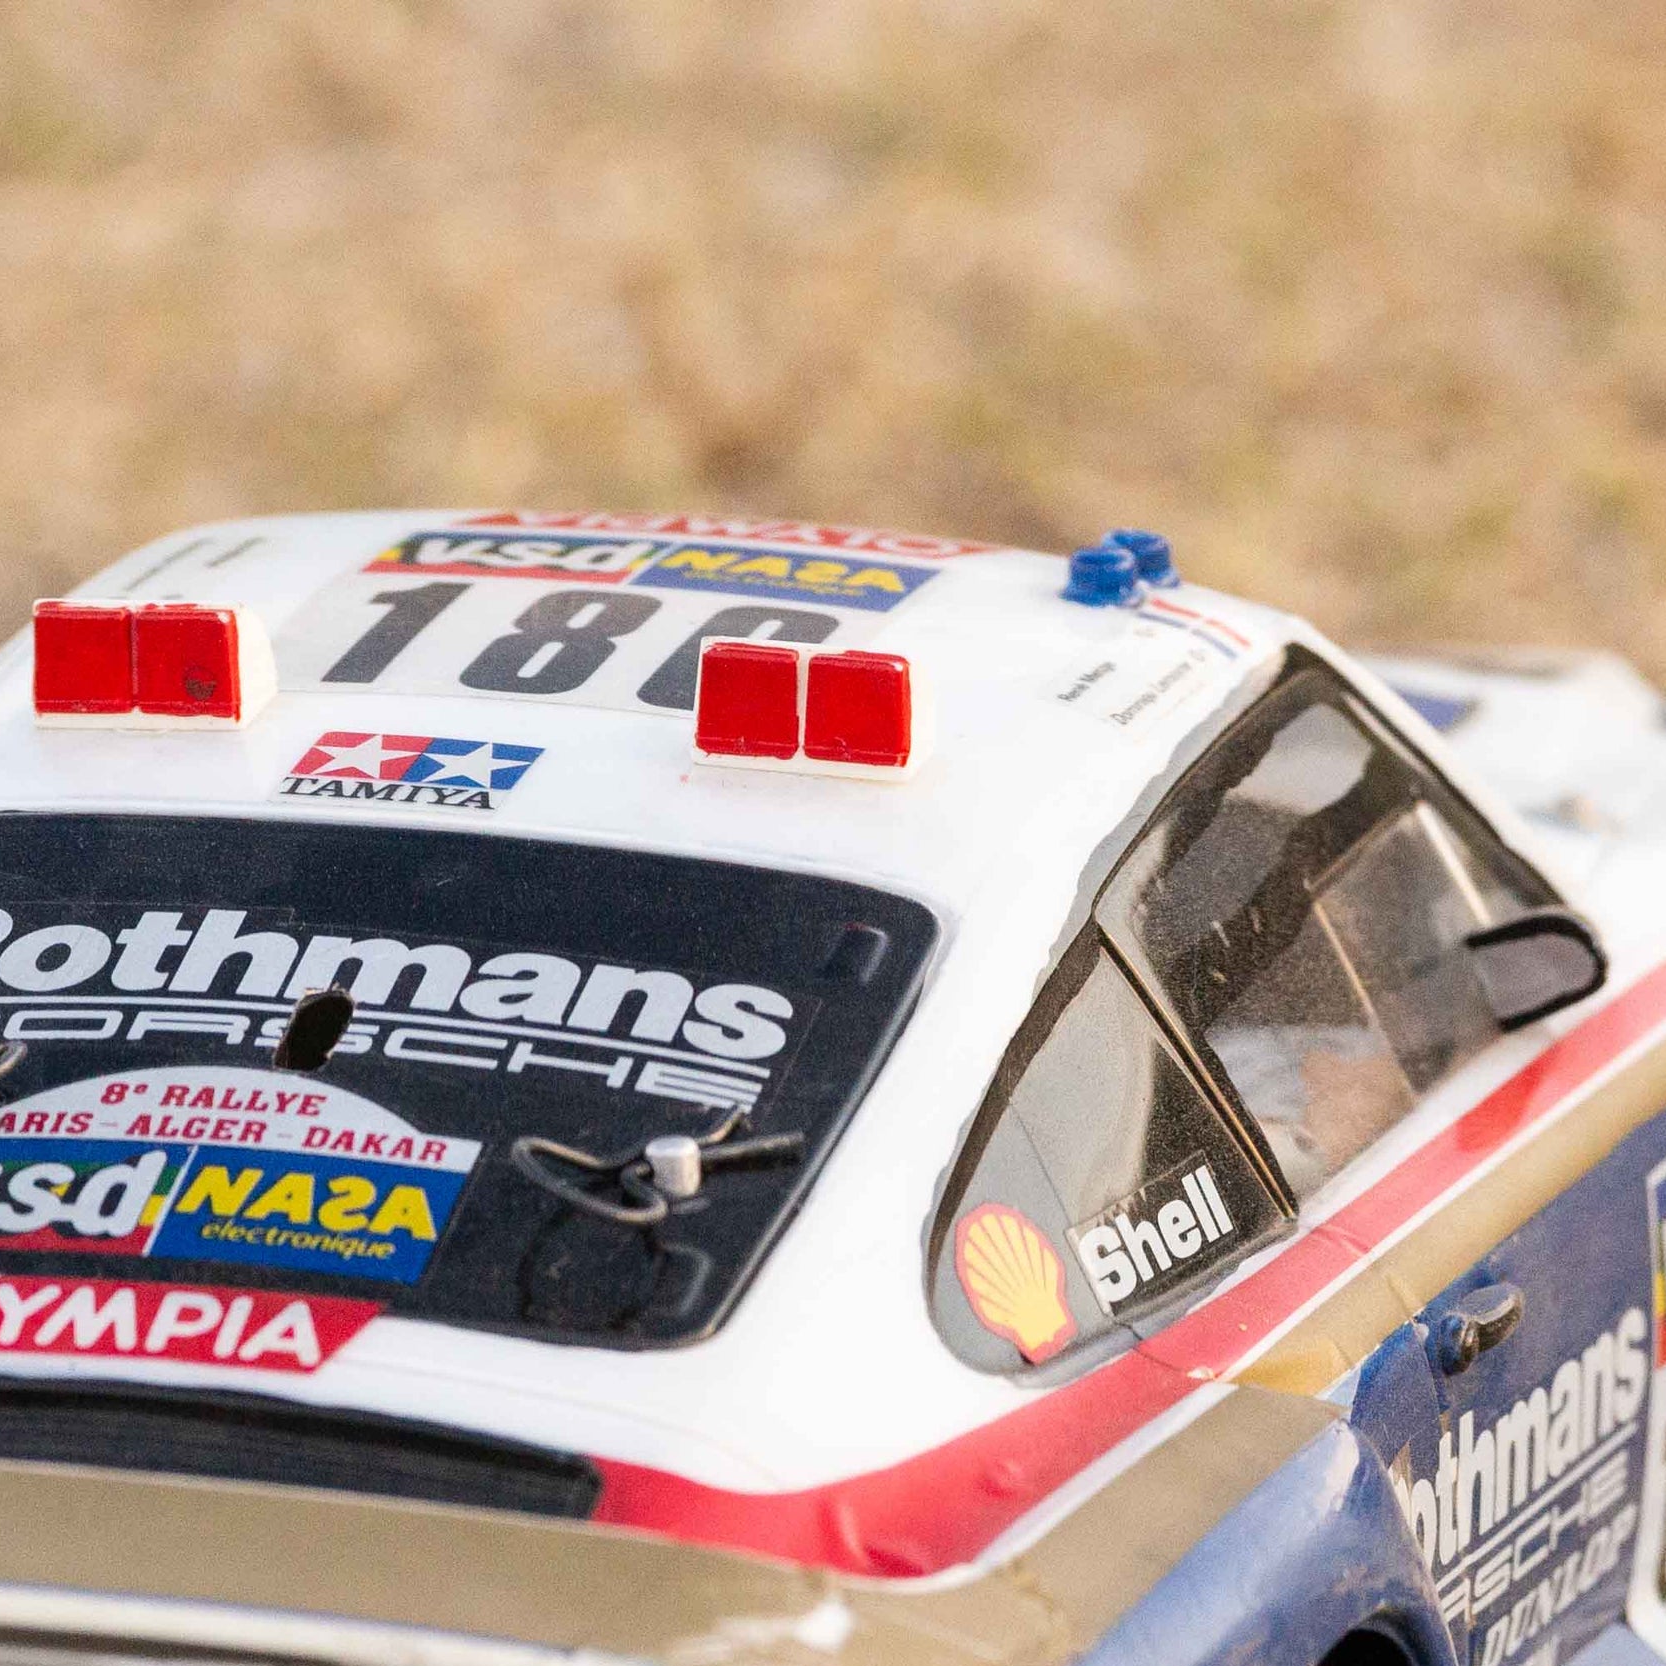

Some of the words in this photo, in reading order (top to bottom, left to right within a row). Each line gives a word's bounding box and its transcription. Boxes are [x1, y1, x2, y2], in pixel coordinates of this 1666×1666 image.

[407, 536, 651, 577] vsd
[279, 776, 495, 810] TAMIYA
[159, 1084, 327, 1117] RALLYE
[125, 1112, 268, 1144] ALGER
[301, 1125, 449, 1163] DAKAR
[1078, 1164, 1234, 1304] Shell
[1387, 1306, 1648, 1575] othmans
